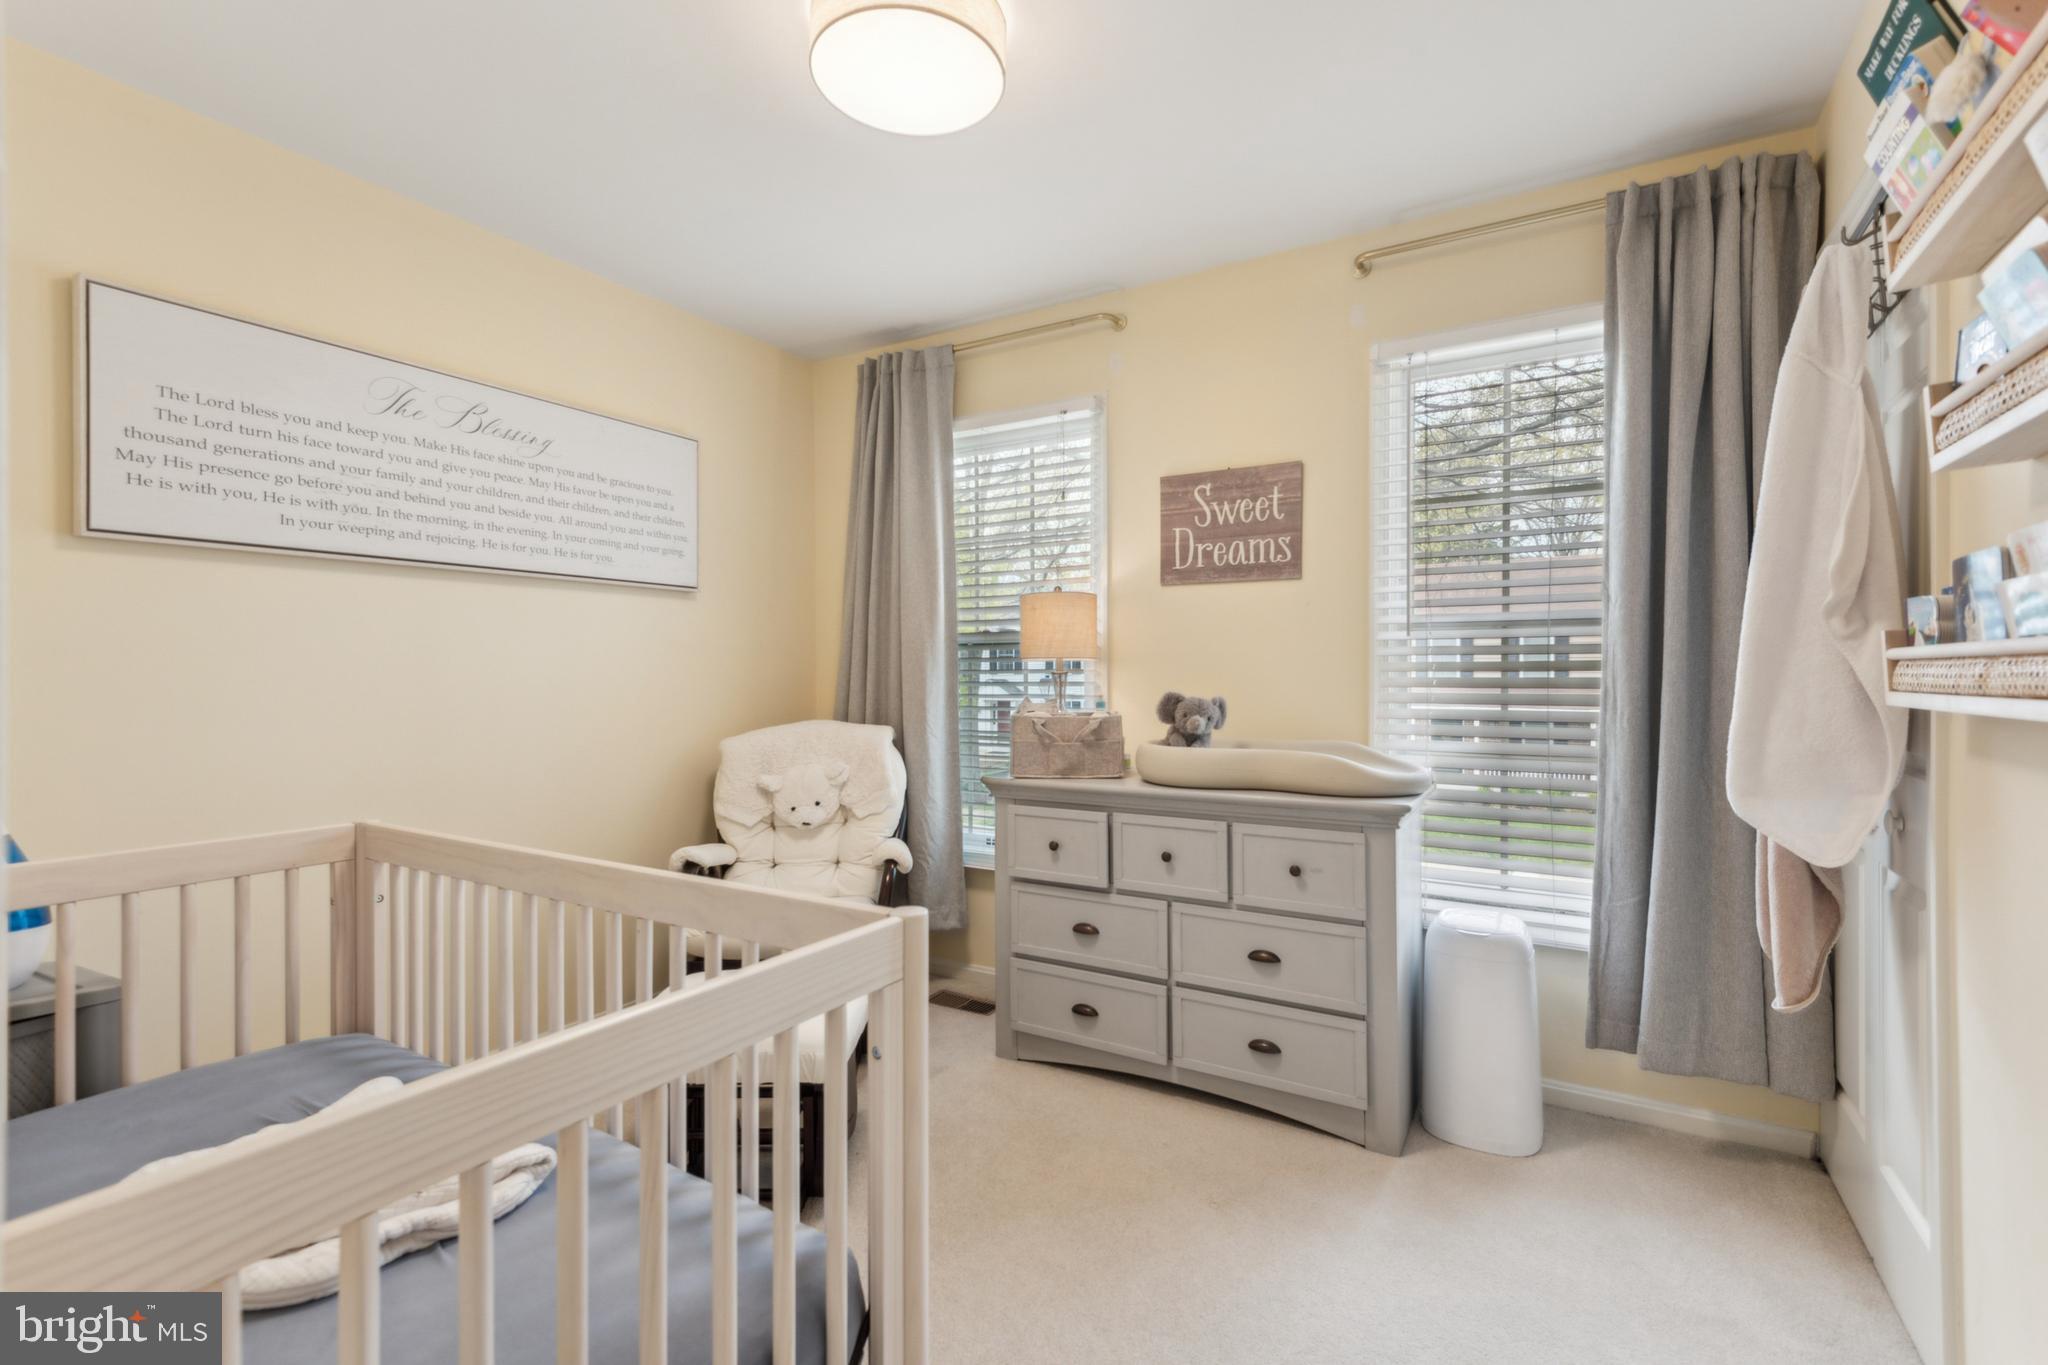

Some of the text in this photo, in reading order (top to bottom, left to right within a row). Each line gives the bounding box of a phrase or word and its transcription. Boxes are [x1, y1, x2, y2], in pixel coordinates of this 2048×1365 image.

[1864, 46, 1882, 82] MAKE
[1884, 13, 1922, 81] DUCKLINGS
[154, 407, 188, 424] The
[193, 414, 233, 432] Lord
[239, 424, 272, 439] turn
[278, 429, 299, 444] his
[304, 434, 332, 450] face
[336, 442, 384, 460] toward
[388, 452, 411, 464] you
[416, 456, 438, 469] and
[442, 462, 466, 474] give
[470, 468, 490, 480] you
[494, 472, 524, 484] peace.
[528, 476, 550, 488] May
[554, 482, 569, 492] His
[573, 485, 598, 497] favor
[156, 384, 189, 402] The
[195, 392, 234, 411] Lord
[241, 400, 279, 420] bless
[284, 413, 311, 426] you
[316, 420, 342, 432] and
[348, 423, 378, 440] keep
[382, 432, 410, 445] you.
[414, 436, 447, 452] Make
[450, 444, 470, 456] His
[474, 450, 495, 462] face
[498, 454, 526, 467] shine
[528, 462, 554, 474] upon
[556, 468, 574, 478] you
[577, 472, 594, 480] and
[597, 473, 607, 482] be
[363, 376, 562, 458] The Blessing
[114, 447, 156, 468] May
[163, 454, 193, 470] His
[199, 462, 270, 481] presence
[274, 472, 293, 486] go
[298, 474, 343, 492] before
[346, 484, 372, 496] you
[376, 488, 400, 500] and
[404, 492, 446, 507] behind
[450, 500, 471, 511] you
[474, 503, 494, 514] and
[498, 505, 531, 520] beside
[558, 514, 572, 526] All
[575, 519, 608, 531] around
[124, 426, 207, 450] thousand
[213, 444, 304, 465] generations
[309, 457, 336, 470] and
[340, 464, 372, 476] your
[376, 466, 416, 485] family
[420, 476, 442, 488] and
[446, 482, 473, 493] your
[476, 486, 523, 502] children,
[526, 494, 544, 504] and
[548, 497, 570, 510] their
[1194, 482, 1285, 527] Sweet
[126, 472, 153, 488] He
[159, 477, 172, 490] is
[179, 482, 217, 496] with
[222, 489, 257, 501] you,
[263, 491, 285, 504] He
[290, 494, 302, 506] is
[306, 497, 338, 512] with
[342, 504, 372, 516] you.
[376, 506, 389, 518] In
[393, 509, 413, 521] the
[416, 514, 470, 530] morning,
[473, 521, 484, 530] in
[487, 522, 504, 533] the
[506, 526, 548, 542] evening.
[553, 530, 563, 540] In
[564, 534, 586, 544] your
[589, 536, 622, 550] coming
[280, 513, 294, 526] In
[299, 518, 333, 531] your
[338, 524, 394, 540] weeping
[398, 528, 422, 541] and
[426, 532, 478, 550] rejoicing.
[482, 538, 498, 550] He
[500, 542, 509, 550] is
[512, 543, 528, 552] for
[554, 546, 568, 556] He
[570, 549, 578, 557] is
[580, 550, 594, 560] for
[1172, 527, 1292, 570] Dreams
